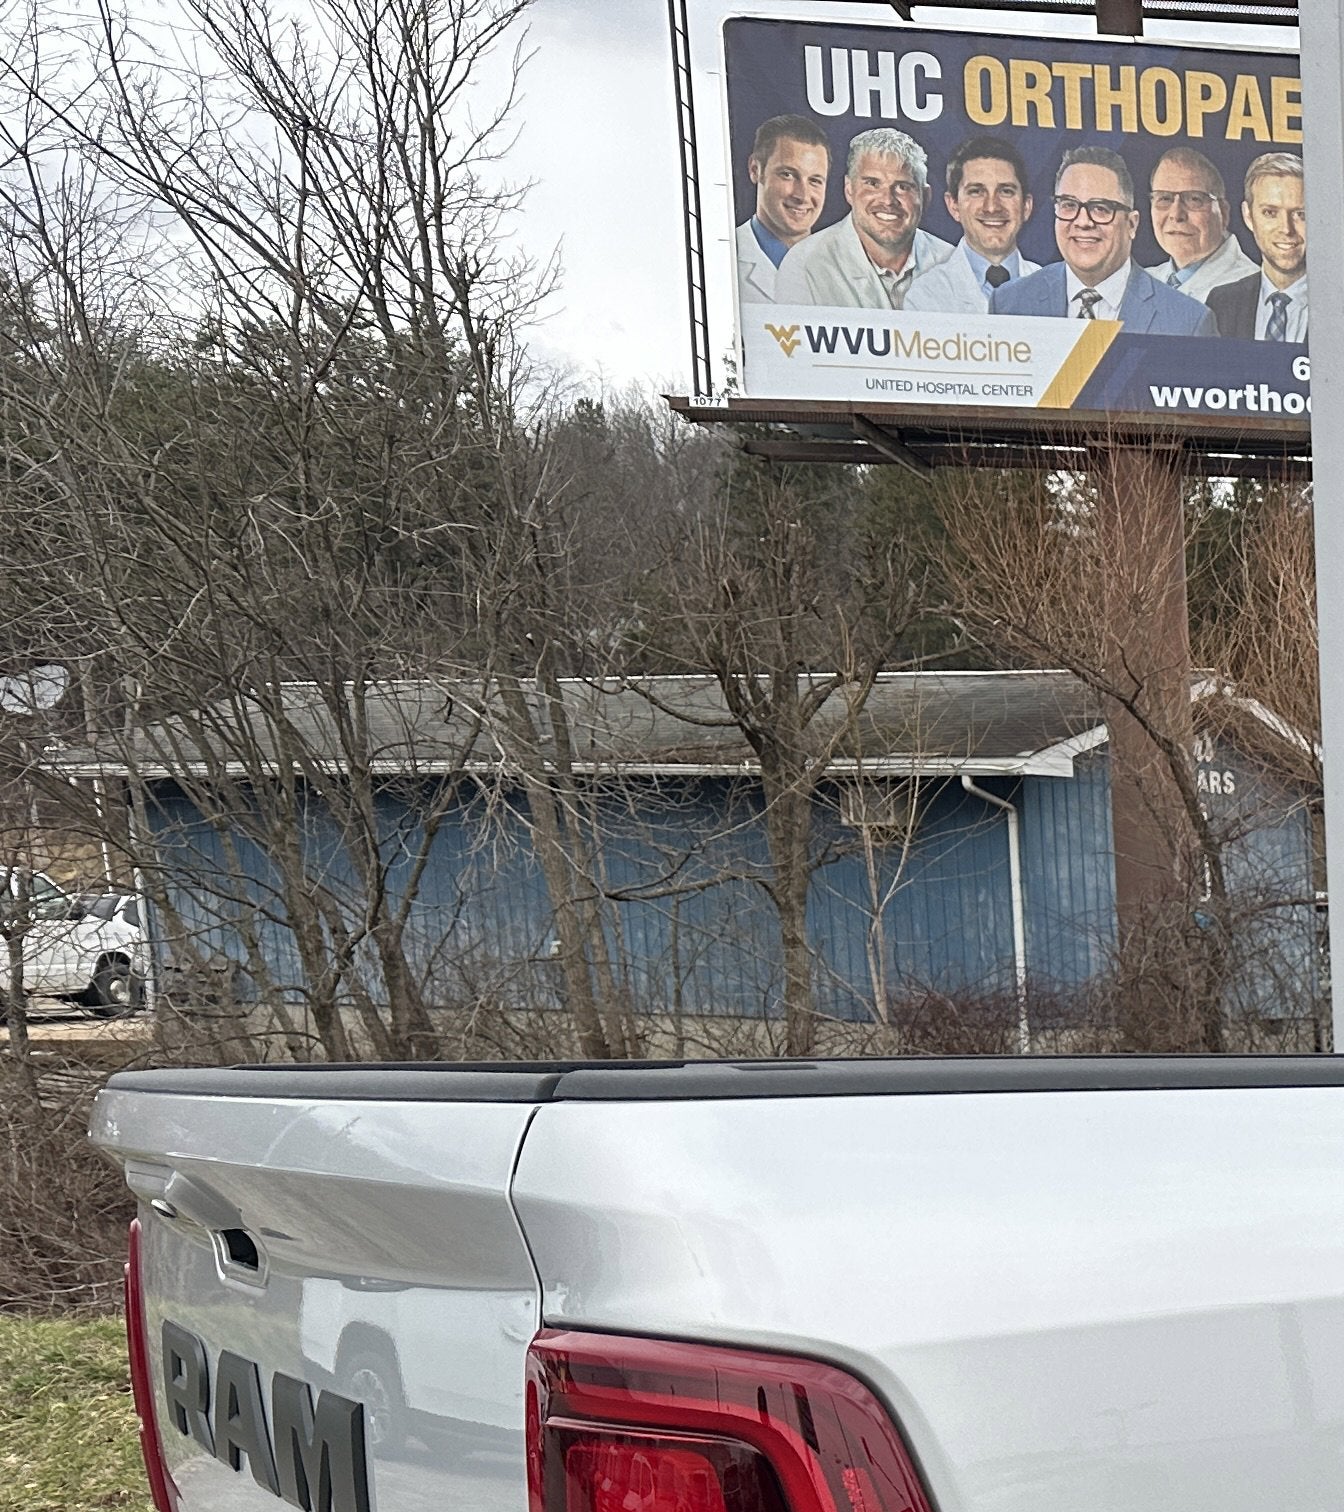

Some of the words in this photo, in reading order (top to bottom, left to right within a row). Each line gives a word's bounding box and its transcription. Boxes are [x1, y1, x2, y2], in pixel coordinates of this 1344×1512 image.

[804, 45, 943, 122] UHC
[865, 378, 913, 392] UNITED
[916, 380, 979, 395] HOSPITAL
[982, 383, 1034, 397] CENTER
[1197, 769, 1236, 795] ARS
